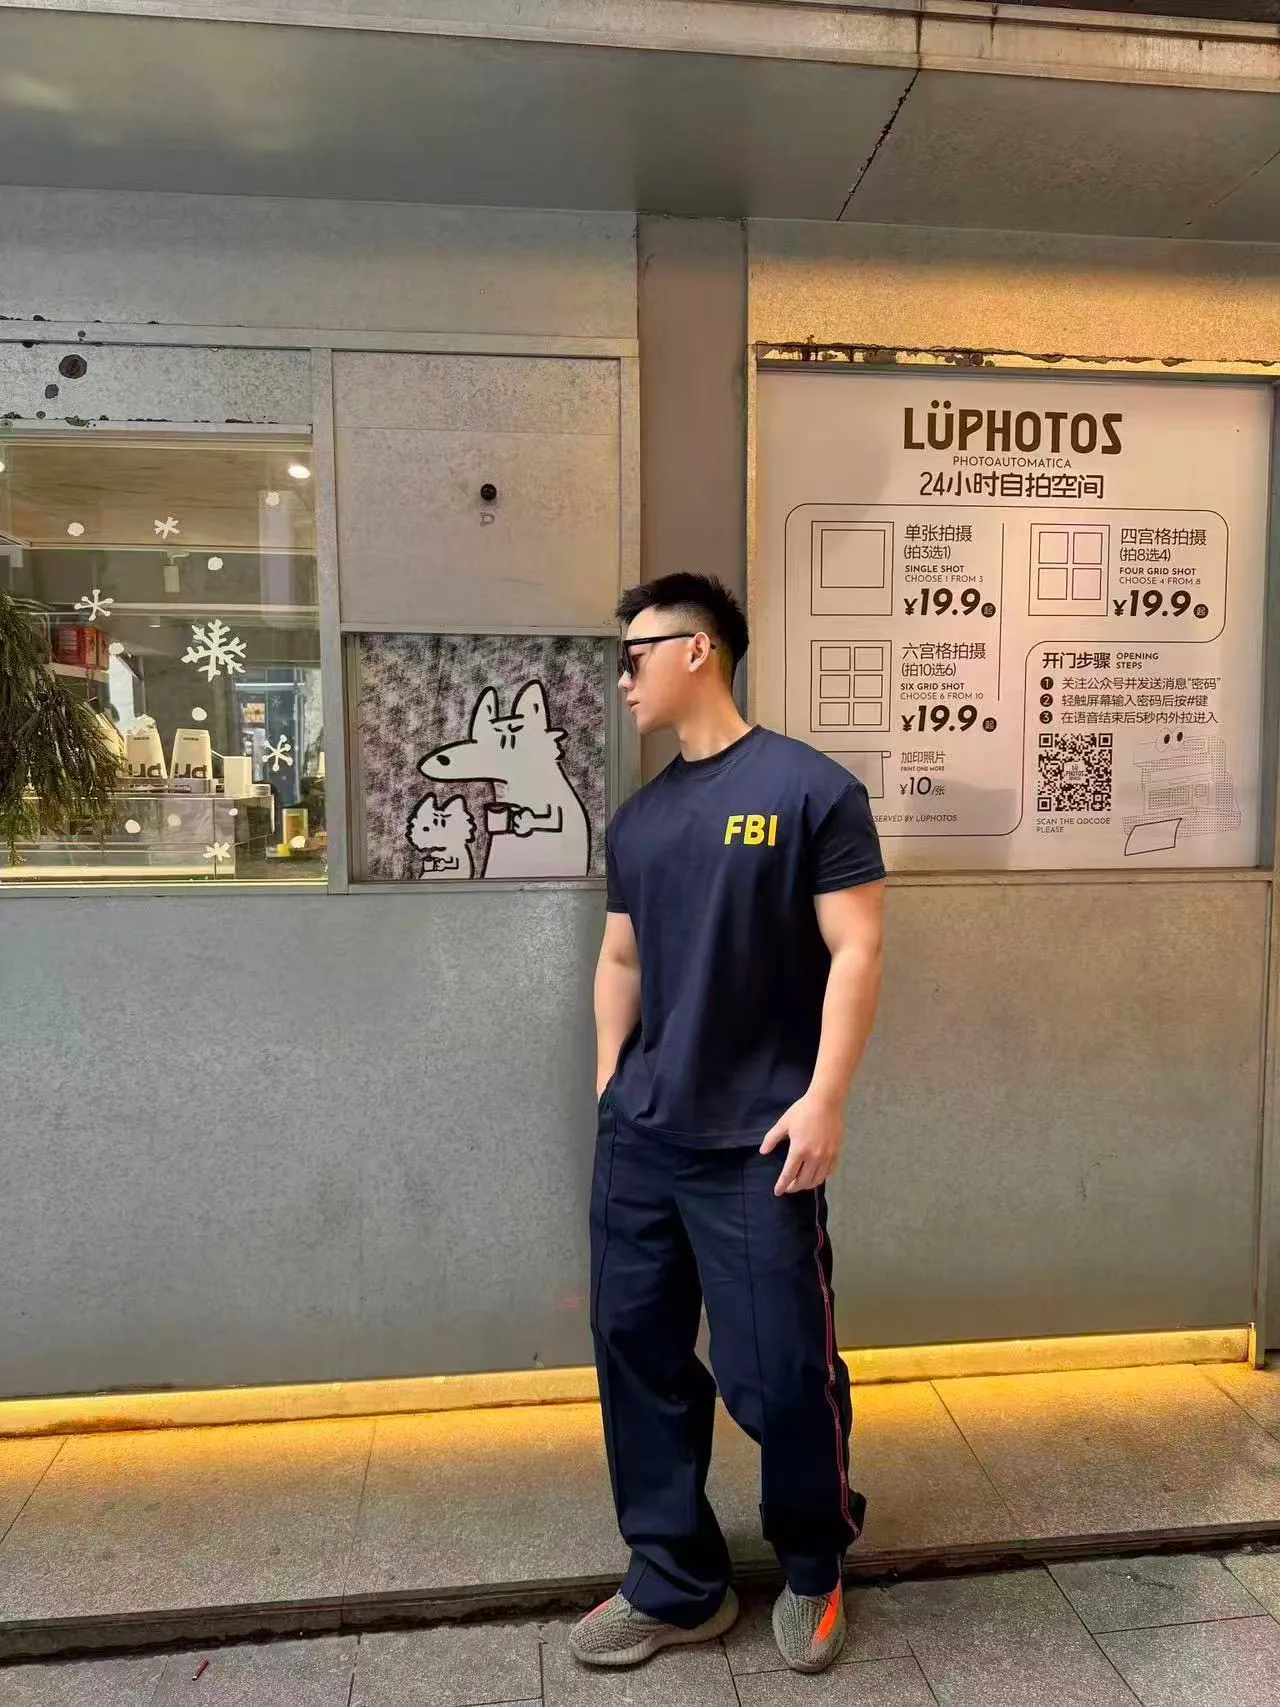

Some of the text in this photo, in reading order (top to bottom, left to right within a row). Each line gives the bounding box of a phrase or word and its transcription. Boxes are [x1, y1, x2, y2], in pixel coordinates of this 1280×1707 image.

[903, 400, 1123, 455] LÜPHOTOS
[953, 456, 1072, 469] PHOTOAUTOMATICA
[919, 471, 1105, 499] 24小时自拍空间
[904, 524, 973, 543] 单张拍摄
[1120, 528, 1207, 546] 四宫格拍摄
[903, 545, 951, 560] (拍3选1)
[1119, 548, 1171, 562] (拍8选4)
[904, 565, 965, 573] SINGLE SHOT
[1119, 567, 1144, 575] FOUR
[1147, 567, 1169, 575] GRID
[904, 575, 943, 583] CHOOSE
[951, 575, 976, 583] FROM
[1119, 577, 1157, 585] CHOOSE
[903, 588, 981, 616] ¥19.9
[1112, 590, 1192, 617] ¥19.9
[902, 642, 987, 660] 六宫格拍摄
[1116, 652, 1159, 660] OPENING
[1042, 652, 1111, 669] 开门步骤
[901, 662, 957, 677] (拍10选6)
[900, 682, 965, 690] SIX GRID SHOT
[900, 692, 984, 700] CHOOSE 6 FROM 10
[1040, 694, 1209, 707] 2 轻触屏幕输入密码后按#键
[901, 704, 978, 732] ¥19.9
[1040, 711, 1219, 724] 3 在语音结束后5秒内外拉进入
[900, 751, 946, 764] 加印照片
[1036, 817, 1057, 825] SCAN
[1059, 817, 1075, 825] THE
[723, 814, 779, 847] FBI
